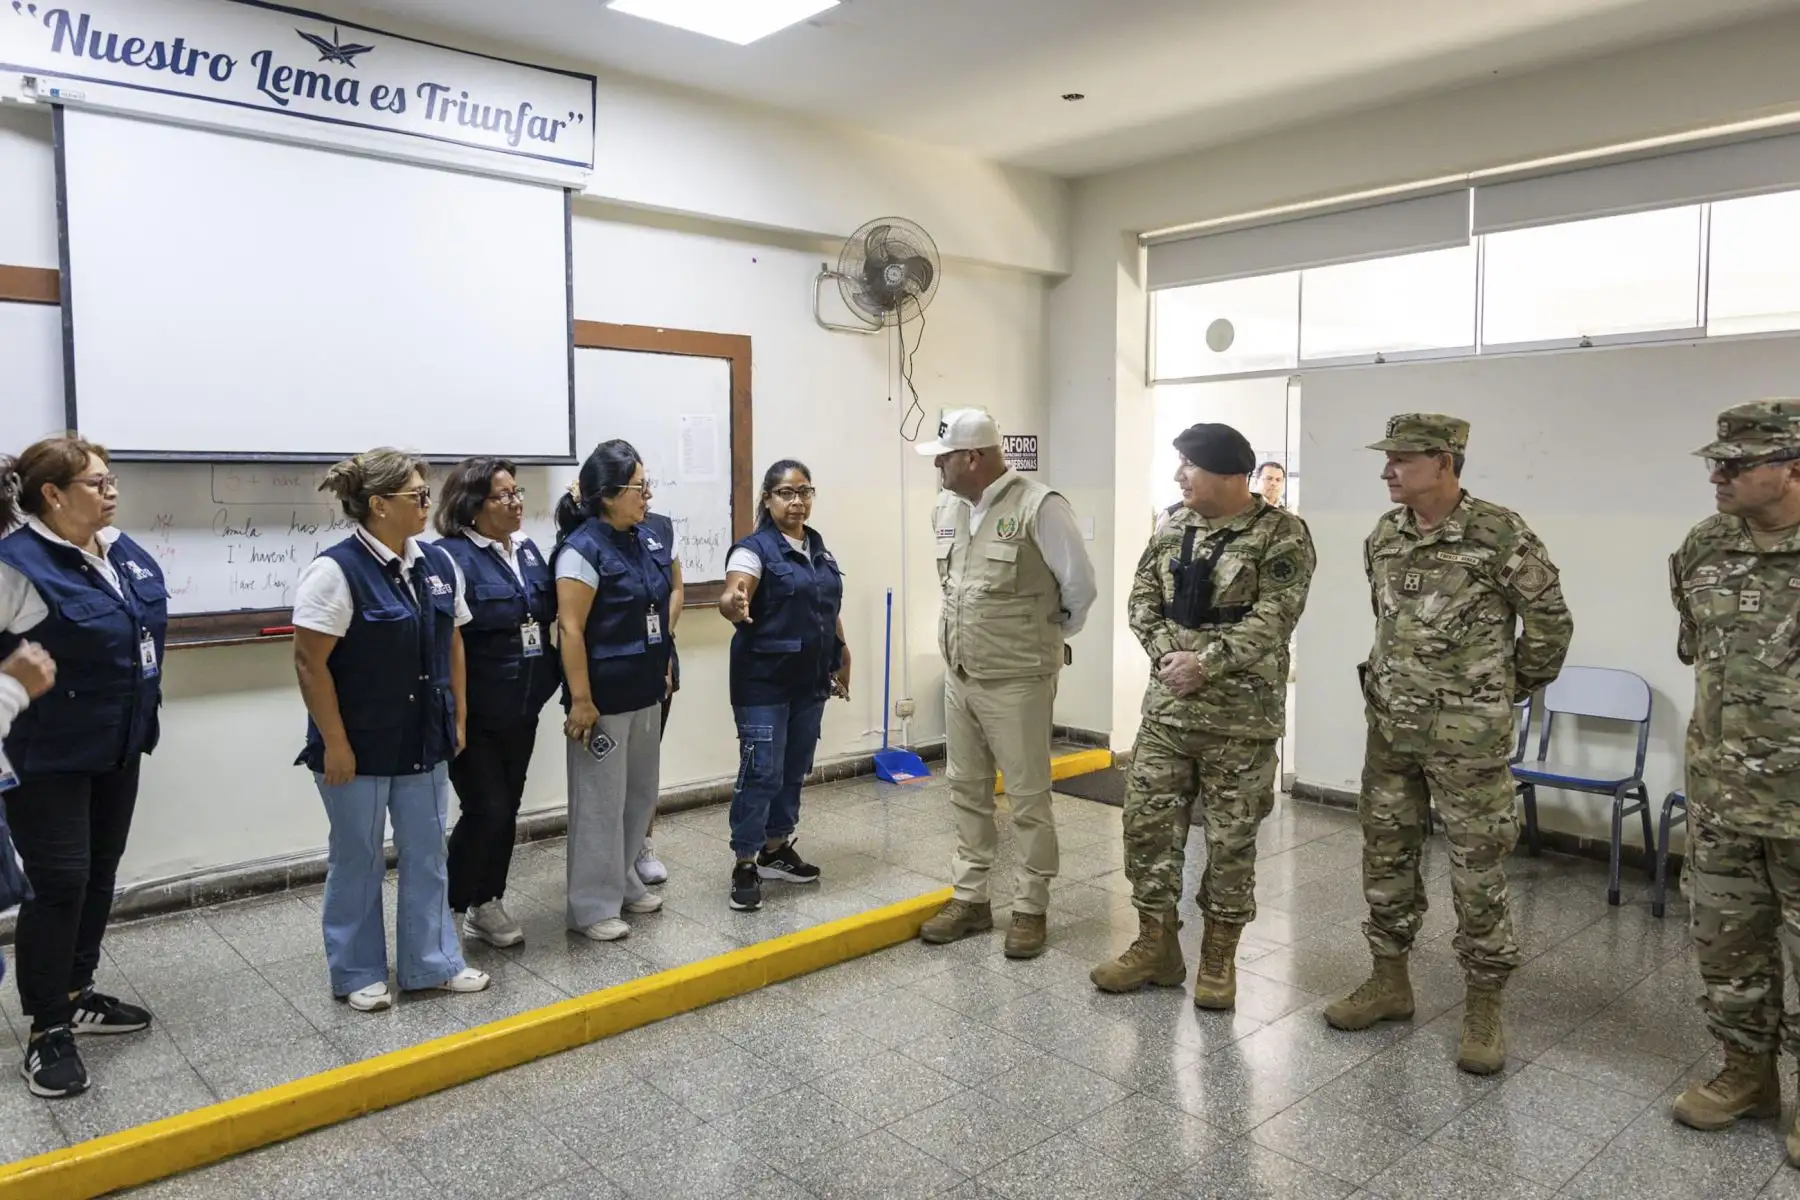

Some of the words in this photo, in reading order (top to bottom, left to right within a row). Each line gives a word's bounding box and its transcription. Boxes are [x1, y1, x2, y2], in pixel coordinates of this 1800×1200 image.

[250, 49, 360, 106] Lema
[369, 85, 407, 115] es
[1003, 437, 1037, 452] AFORO
[287, 511, 320, 537] has
